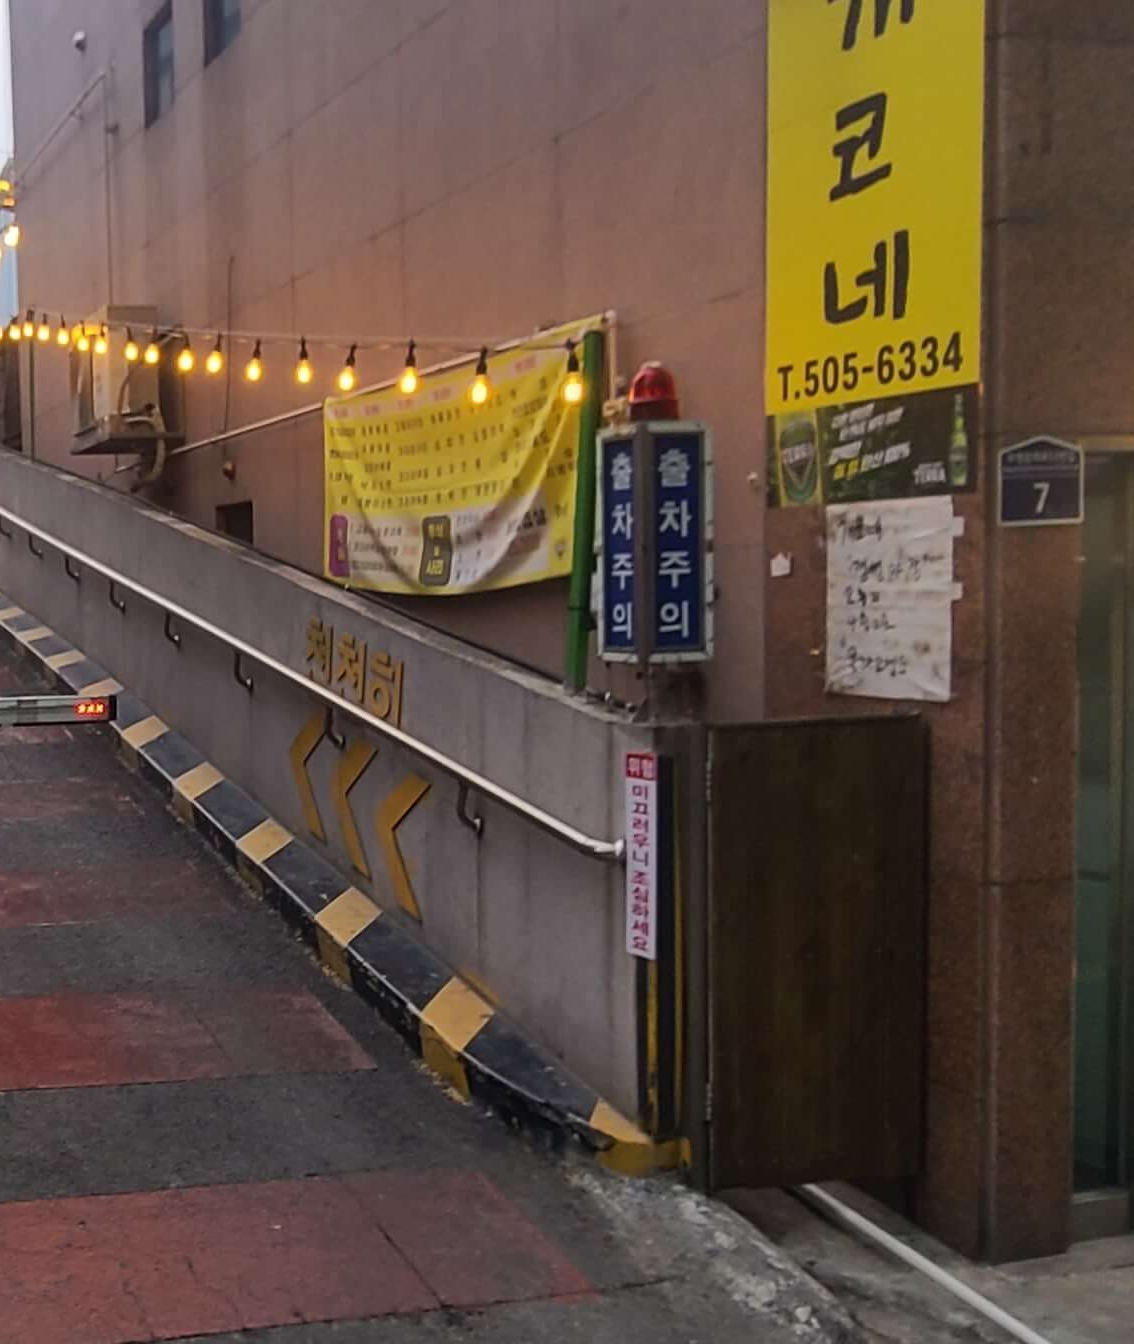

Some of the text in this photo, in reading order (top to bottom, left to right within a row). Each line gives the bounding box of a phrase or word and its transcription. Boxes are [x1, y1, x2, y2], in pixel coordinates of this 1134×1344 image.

[777, 332, 964, 401] T.505-6334
[610, 452, 635, 640] 출차주의
[658, 447, 692, 639] 출차주의
[1033, 482, 1051, 514] 7
